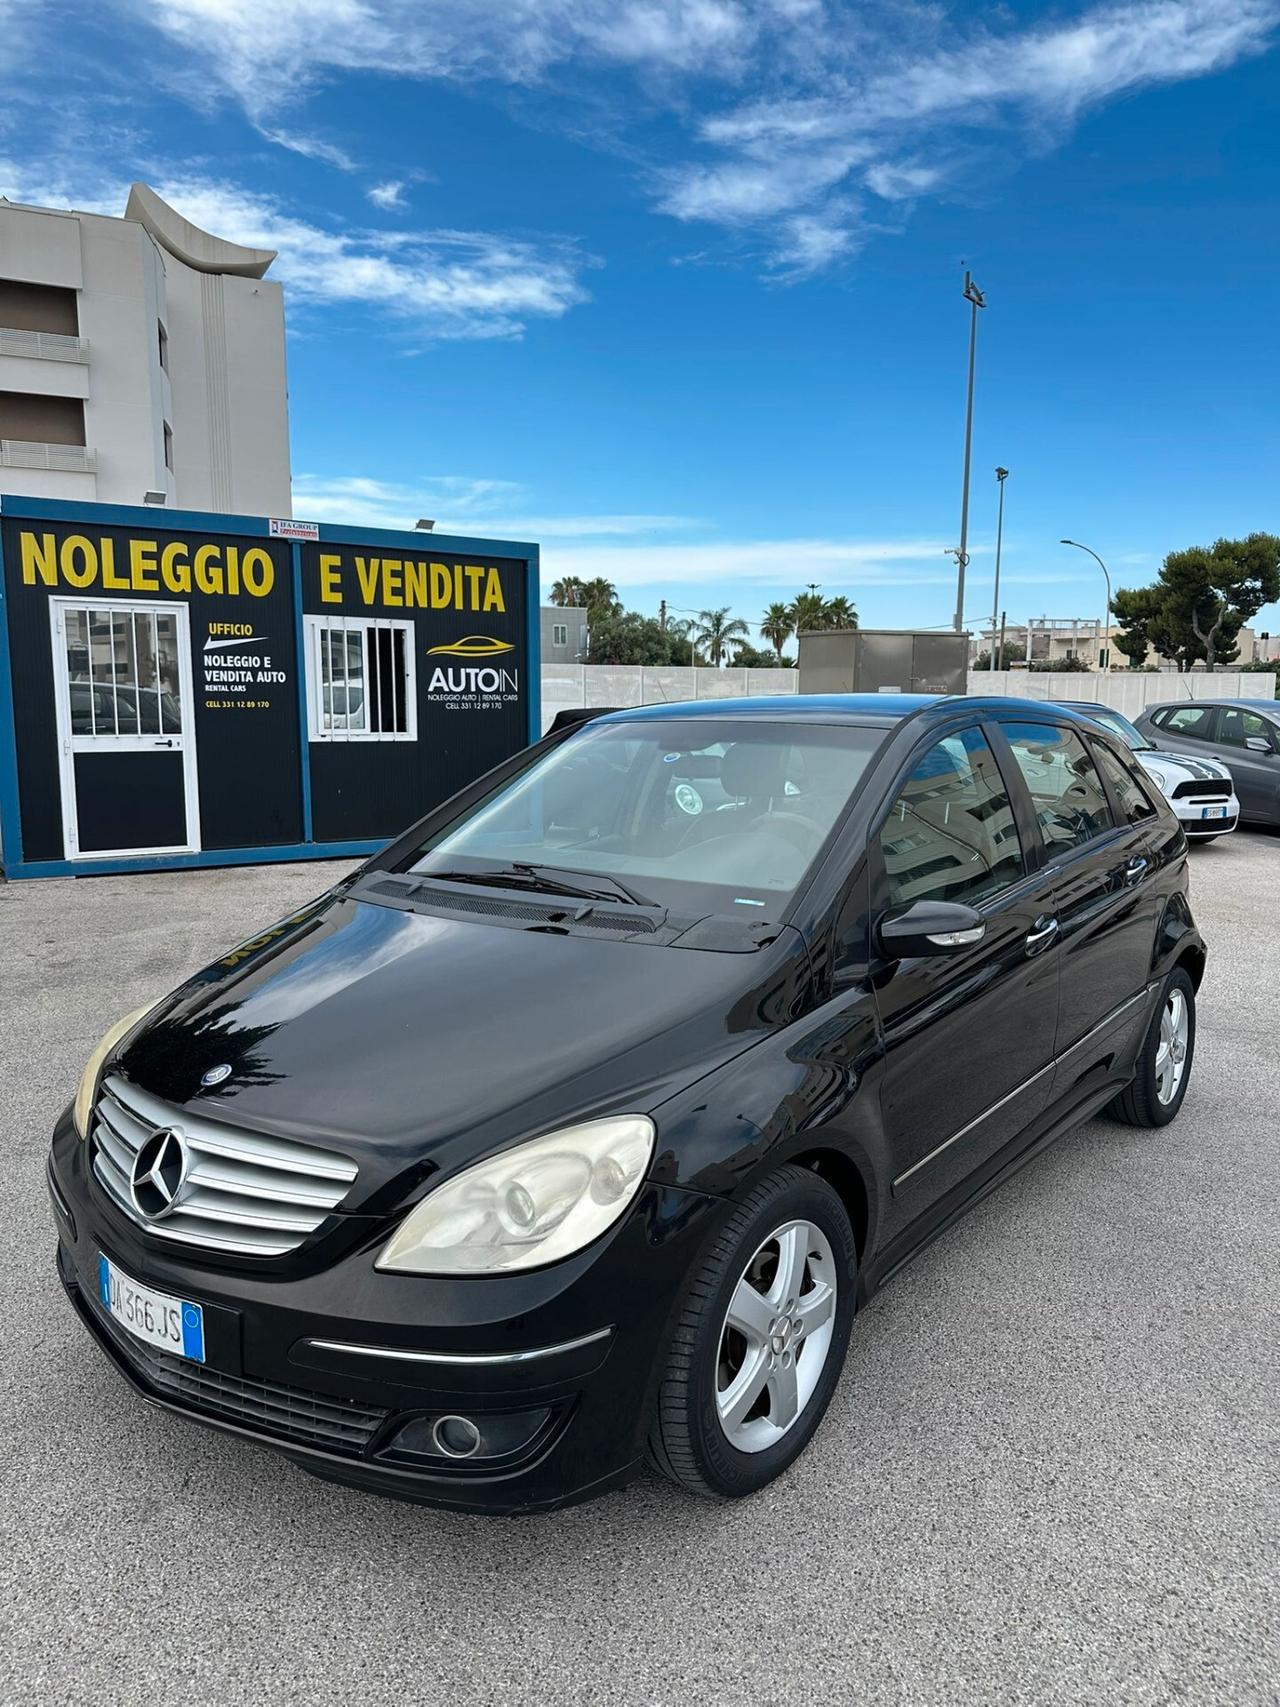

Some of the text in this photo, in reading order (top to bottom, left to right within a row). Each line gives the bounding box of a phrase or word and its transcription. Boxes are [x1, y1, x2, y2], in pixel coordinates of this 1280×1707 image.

[292, 523, 317, 531] GROUP
[20, 532, 505, 613] NOLEGGIO E VENDITA
[209, 622, 253, 636] UFFICIO
[204, 655, 272, 668] NOLEGGIO E
[204, 670, 287, 683] VENDITA AUTO
[427, 667, 518, 692] AUTOIN
[205, 684, 246, 692] RENTAL CARS
[205, 700, 221, 708] CELL
[222, 700, 235, 708] 331
[445, 702, 502, 710] CELL 331 12 89 170
